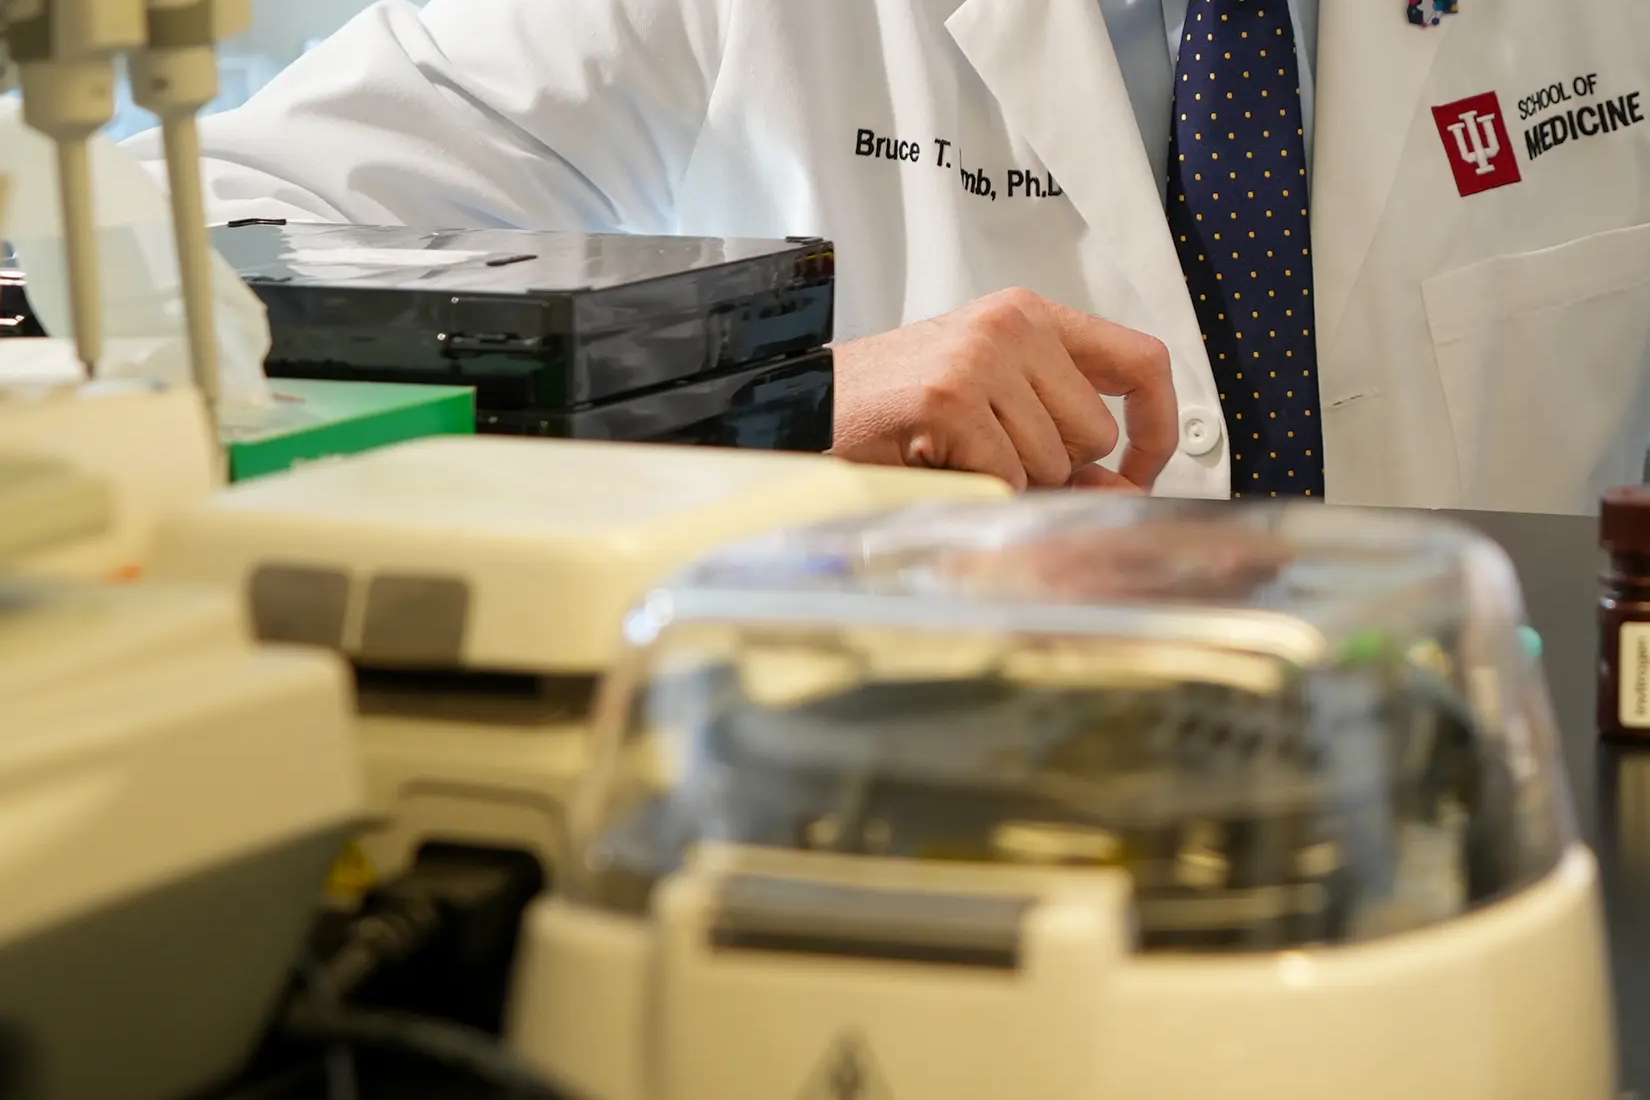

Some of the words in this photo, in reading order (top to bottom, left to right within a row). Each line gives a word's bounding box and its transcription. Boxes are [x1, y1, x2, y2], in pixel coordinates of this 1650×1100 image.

[1517, 81, 1572, 121] SCHOOL
[1572, 73, 1598, 97] OF
[854, 128, 921, 163] Bruce
[934, 138, 952, 169] T.
[1523, 90, 1645, 162] MEDICINE
